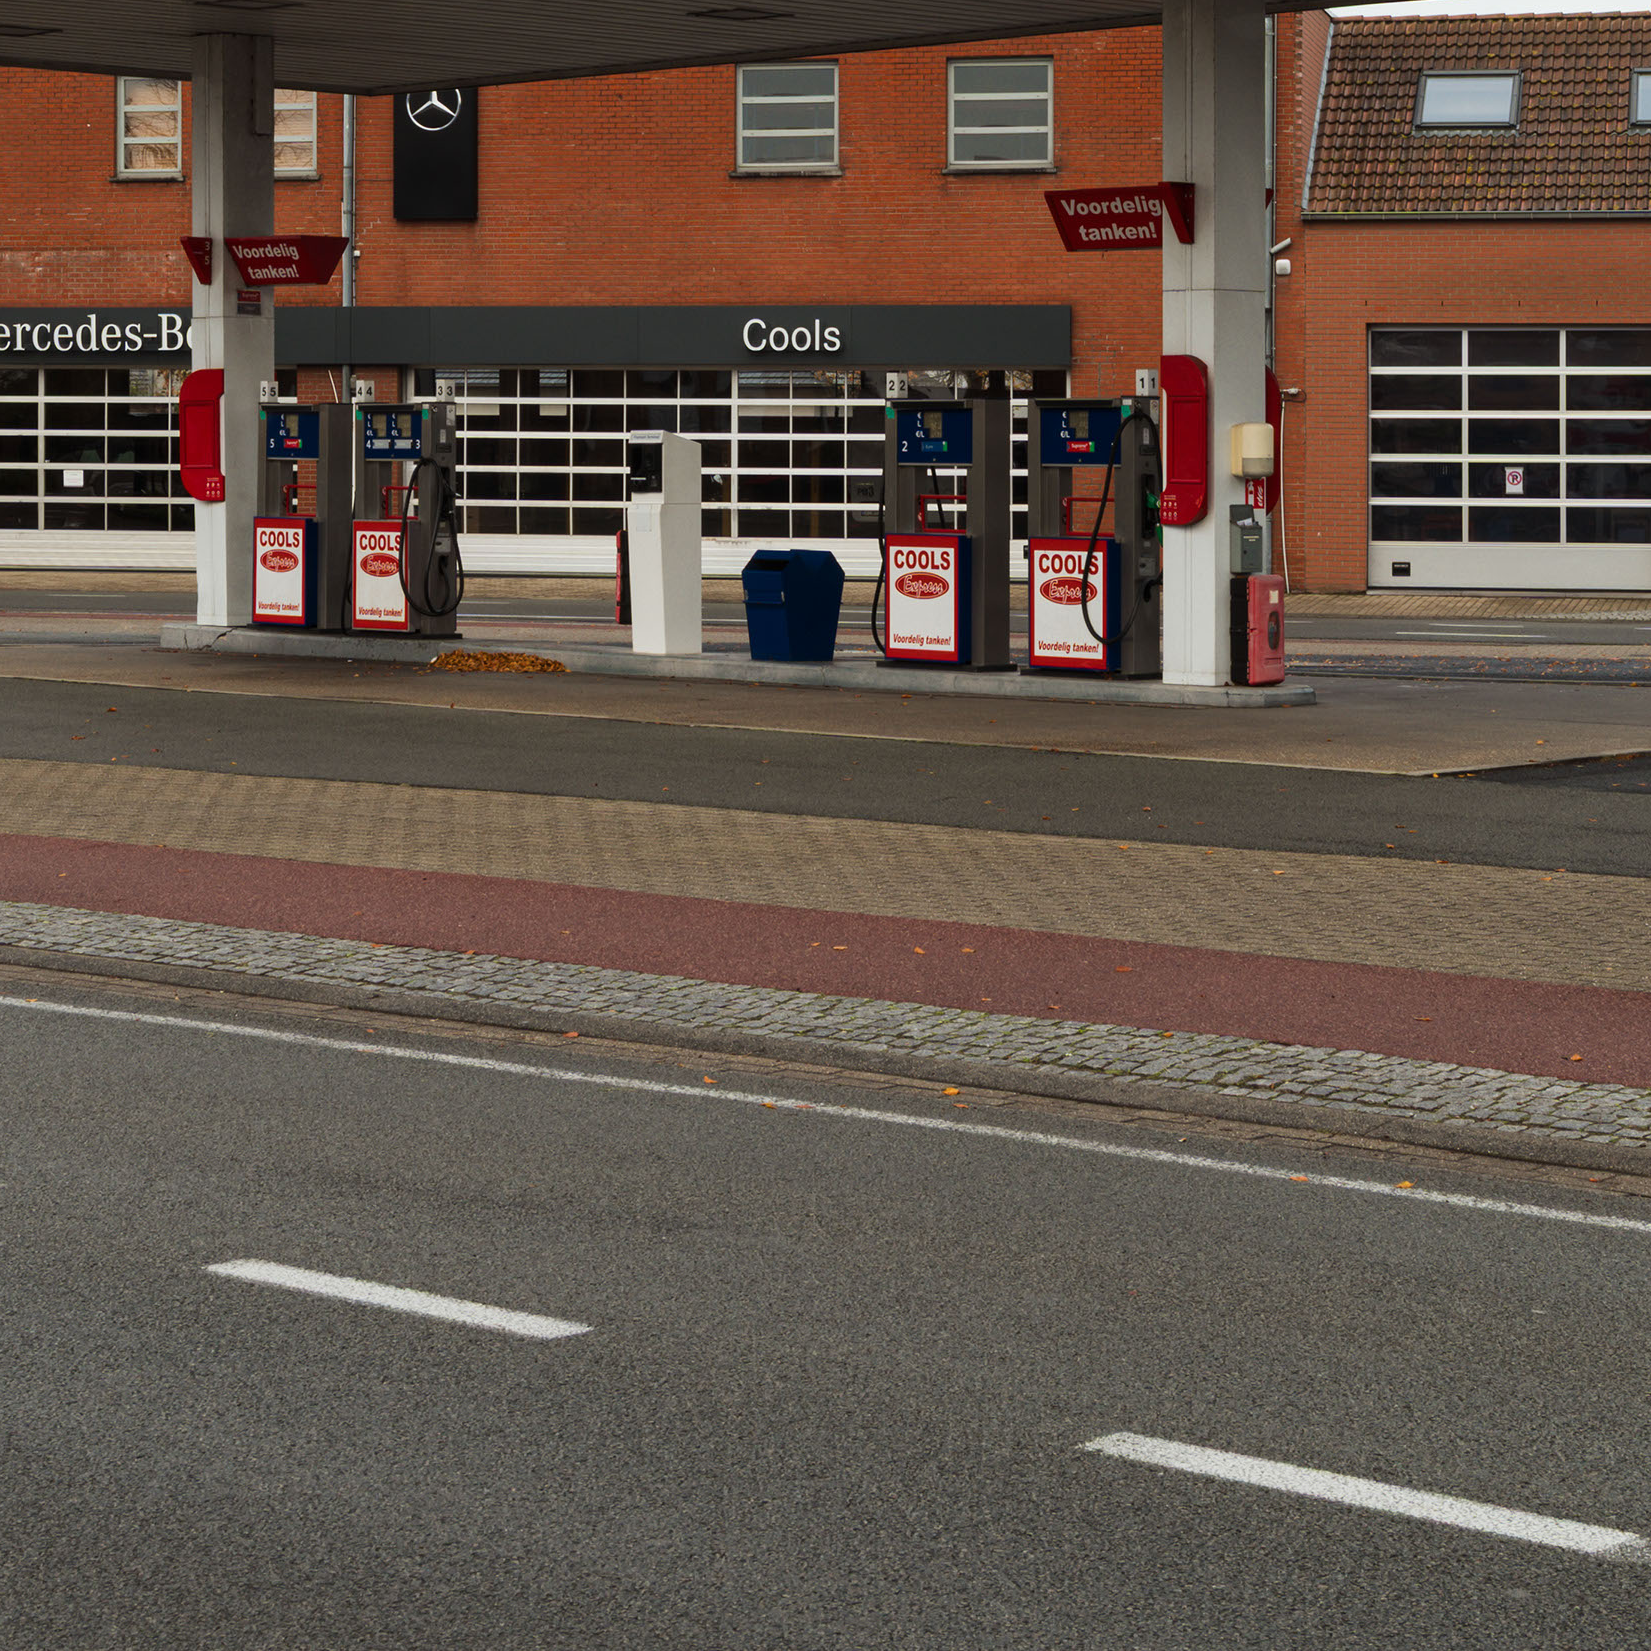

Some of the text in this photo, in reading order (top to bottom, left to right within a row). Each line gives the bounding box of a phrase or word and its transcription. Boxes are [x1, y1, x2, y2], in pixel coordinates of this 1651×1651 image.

[1060, 196, 1162, 216] Voordelig
[1079, 222, 1157, 242] tanken!
[232, 243, 300, 261] Voordelig
[248, 264, 300, 280] tanken!
[742, 318, 841, 352] Cools
[889, 380, 895, 391] 2
[900, 380, 906, 390] 2
[1139, 378, 1144, 389] 1
[1150, 377, 1156, 388] 1
[262, 386, 267, 396] 5
[270, 387, 276, 397] 5
[357, 386, 362, 396] 4
[366, 386, 373, 396] 4
[438, 386, 443, 396] 3
[447, 386, 452, 396] 3
[270, 439, 275, 448] 5
[366, 440, 371, 448] 4
[416, 440, 421, 449] 3
[902, 440, 908, 452] 2
[260, 530, 300, 548] COOLS
[359, 534, 401, 552] COOLS
[894, 549, 951, 570] COOLS
[1039, 554, 1099, 575] COOLS
[903, 574, 944, 598] Express
[1049, 579, 1091, 604] Expres
[258, 601, 300, 612] Voordelig tanken!
[358, 606, 403, 618] Voordelig tanken!
[893, 634, 952, 646] Voordelig tanken!
[1038, 640, 1099, 654] Voordelig tanken!
